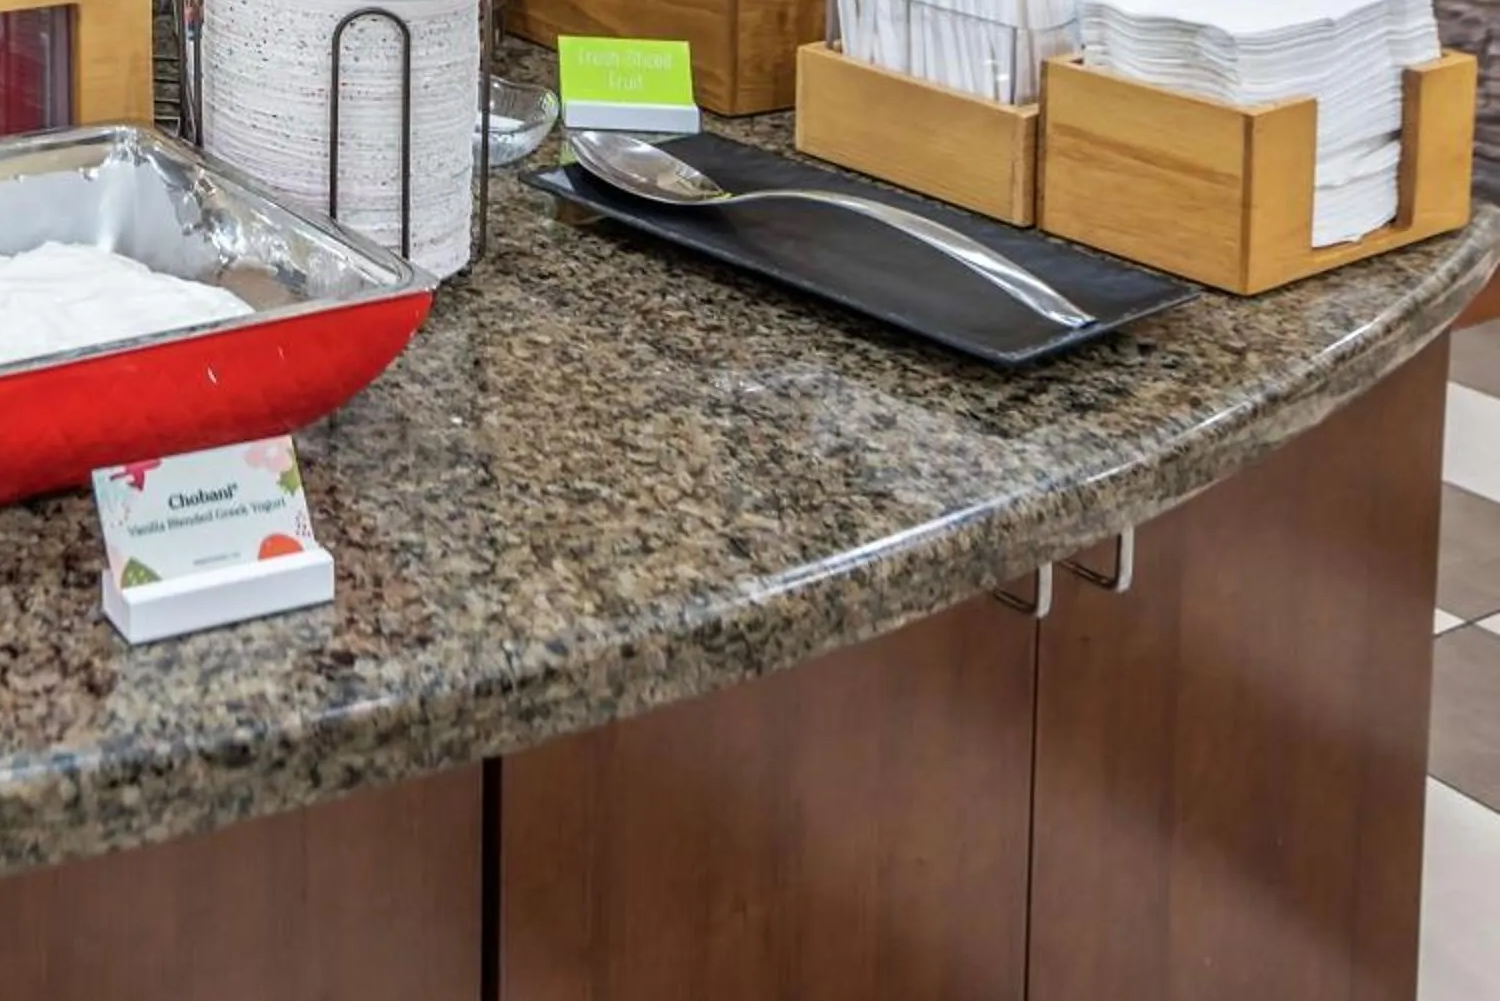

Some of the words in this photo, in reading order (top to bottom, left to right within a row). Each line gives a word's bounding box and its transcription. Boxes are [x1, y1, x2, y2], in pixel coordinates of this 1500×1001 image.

[127, 520, 166, 537] Vanilla
[168, 512, 214, 530] Blended
[215, 505, 248, 521] Greek
[252, 497, 287, 515] Yogurt
